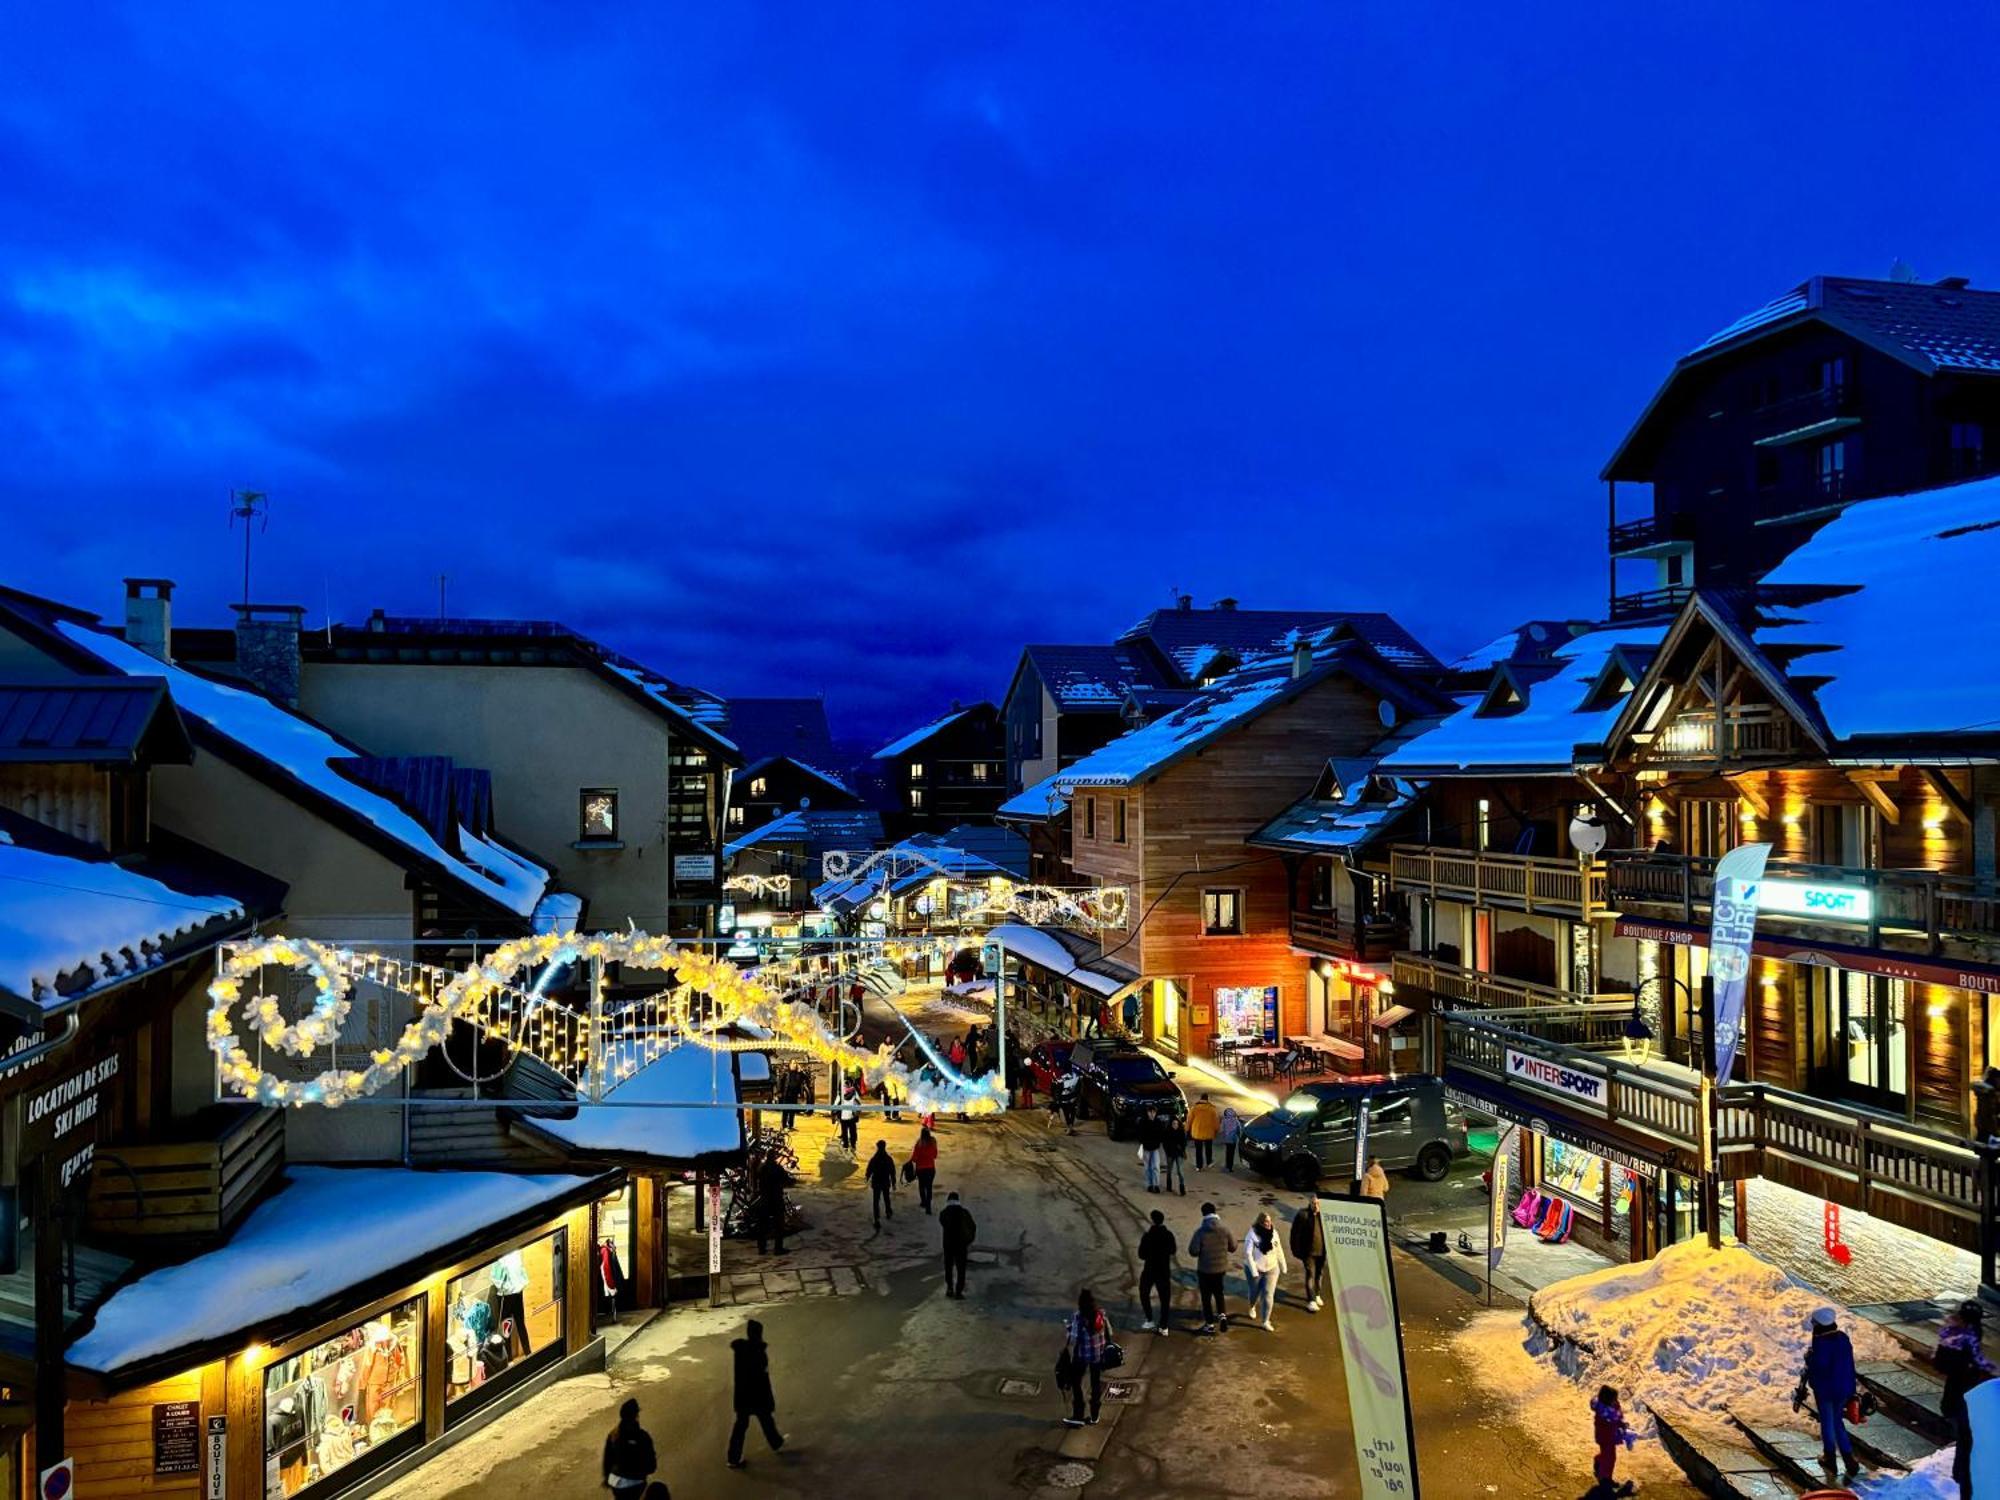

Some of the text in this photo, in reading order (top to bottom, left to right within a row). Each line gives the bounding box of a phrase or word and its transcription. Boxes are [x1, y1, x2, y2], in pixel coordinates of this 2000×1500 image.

[28, 1053, 120, 1124] LOCATION DE SKIS
[1524, 1058, 1600, 1098] INTERSPORT
[54, 1092, 99, 1139] SKI HIRE
[213, 1435, 221, 1496] BOUTIQUE
